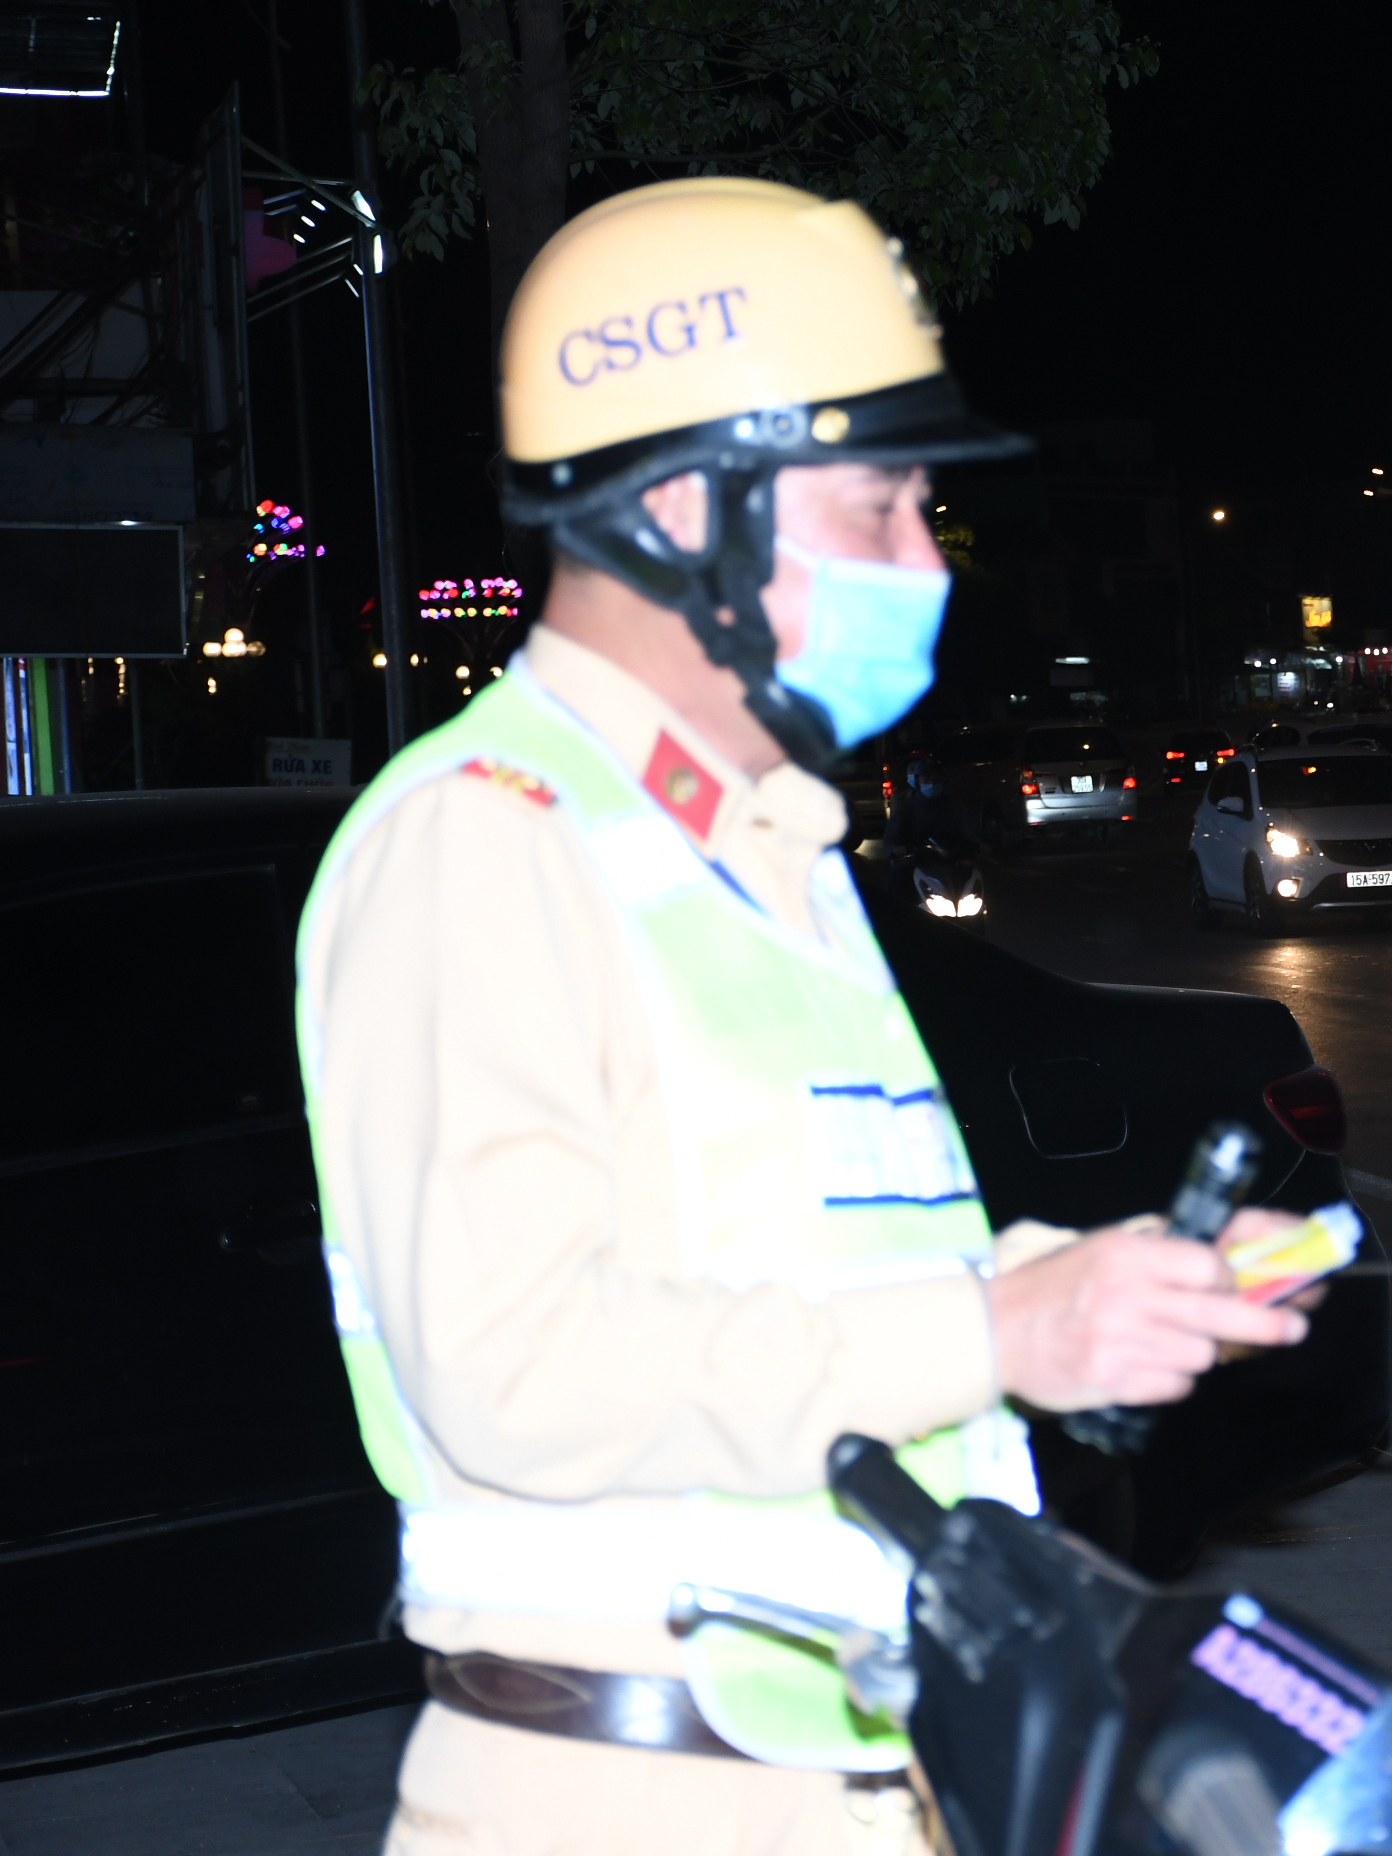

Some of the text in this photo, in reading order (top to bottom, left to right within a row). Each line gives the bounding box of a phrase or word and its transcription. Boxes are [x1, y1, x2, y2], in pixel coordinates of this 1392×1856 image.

[558, 285, 747, 387] CSGT
[272, 754, 333, 774] RỬA XE
